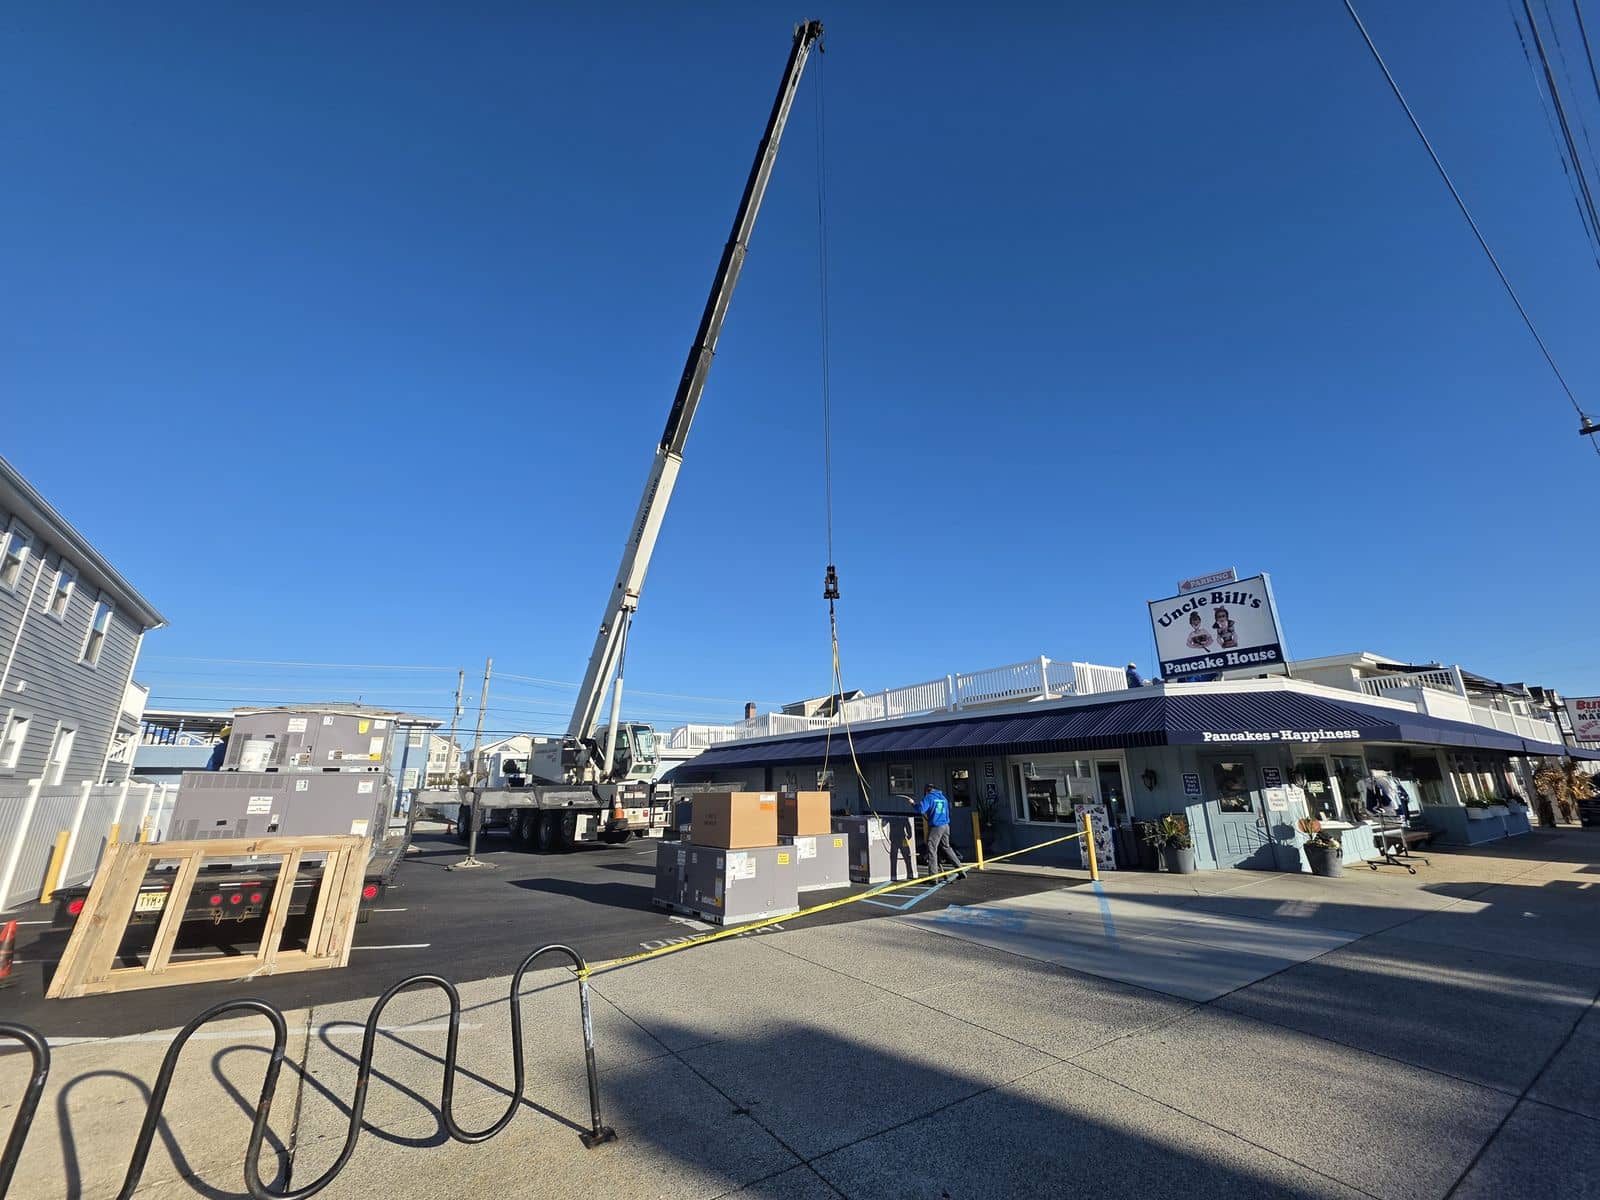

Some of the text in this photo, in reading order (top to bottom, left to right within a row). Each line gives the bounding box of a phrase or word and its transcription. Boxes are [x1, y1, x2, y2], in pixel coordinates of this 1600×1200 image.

[1190, 572, 1229, 588] PARKING
[1158, 591, 1262, 628] Uncle Bill's
[1164, 649, 1277, 675] Pancake House
